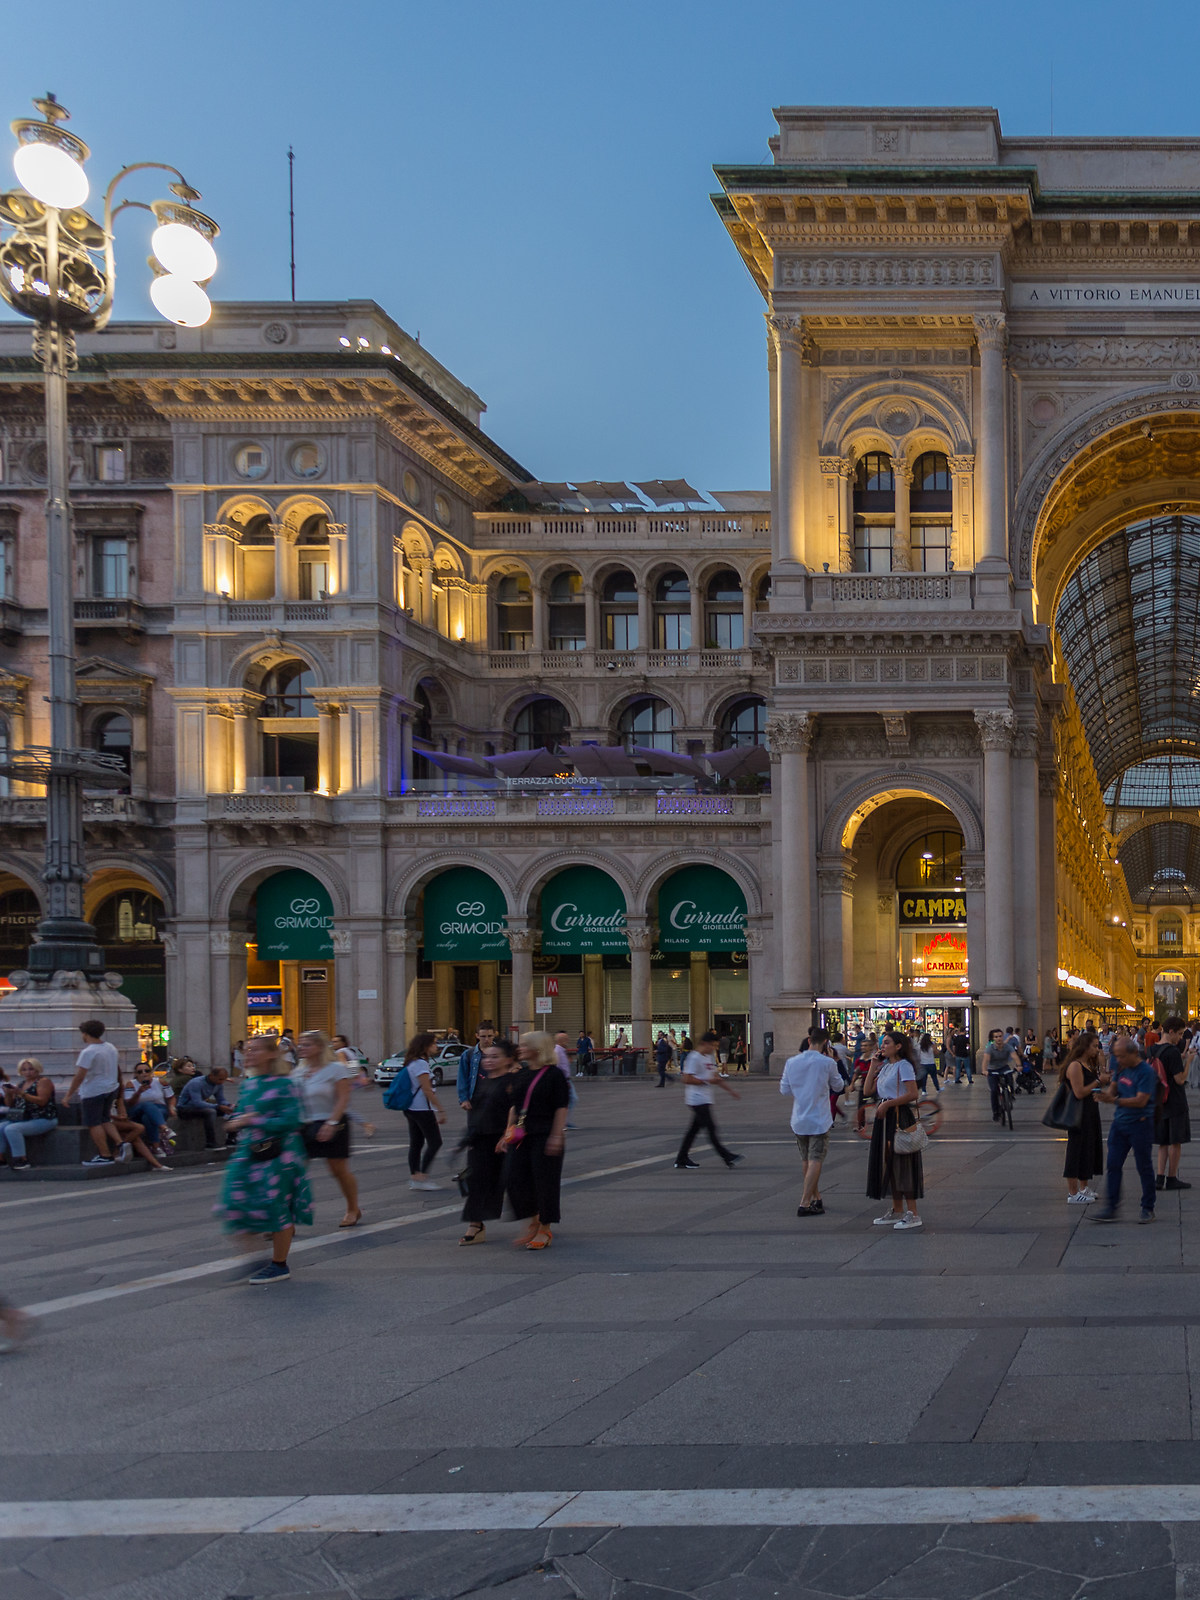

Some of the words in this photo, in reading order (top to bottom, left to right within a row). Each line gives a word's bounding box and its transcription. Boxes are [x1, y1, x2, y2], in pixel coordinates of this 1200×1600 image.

[1030, 289, 1039, 300] A
[1050, 289, 1121, 300] VITTORIO
[555, 776, 588, 785] DUOMO
[670, 901, 744, 930] Currado
[903, 899, 966, 918] CAMPA
[551, 903, 626, 932] Currado
[549, 980, 558, 992] M
